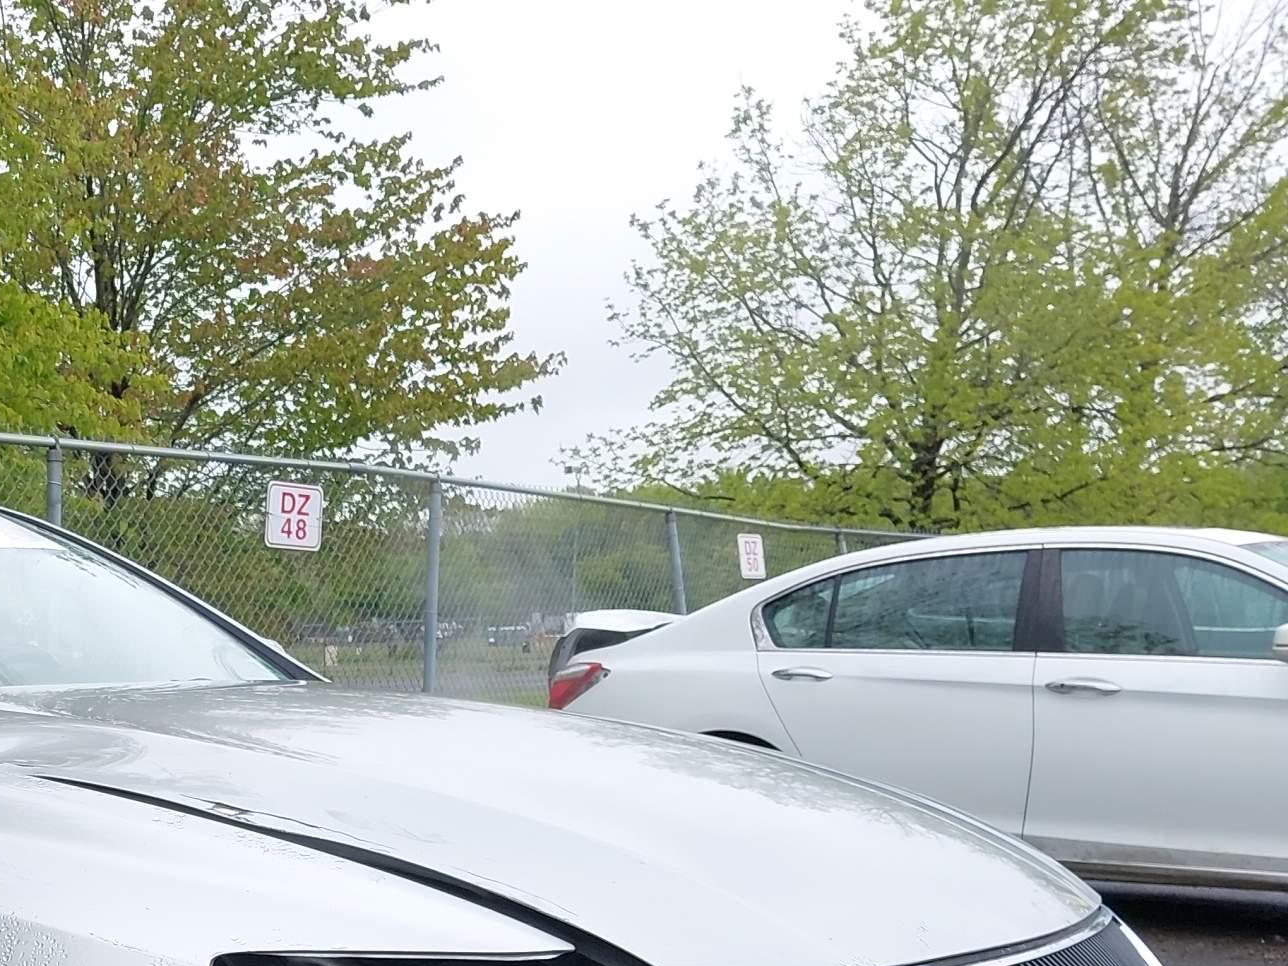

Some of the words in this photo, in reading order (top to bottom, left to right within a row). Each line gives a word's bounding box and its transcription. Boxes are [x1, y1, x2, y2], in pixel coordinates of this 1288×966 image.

[280, 492, 311, 516] DZ
[280, 518, 307, 540] 48
[744, 541, 759, 556] DZ
